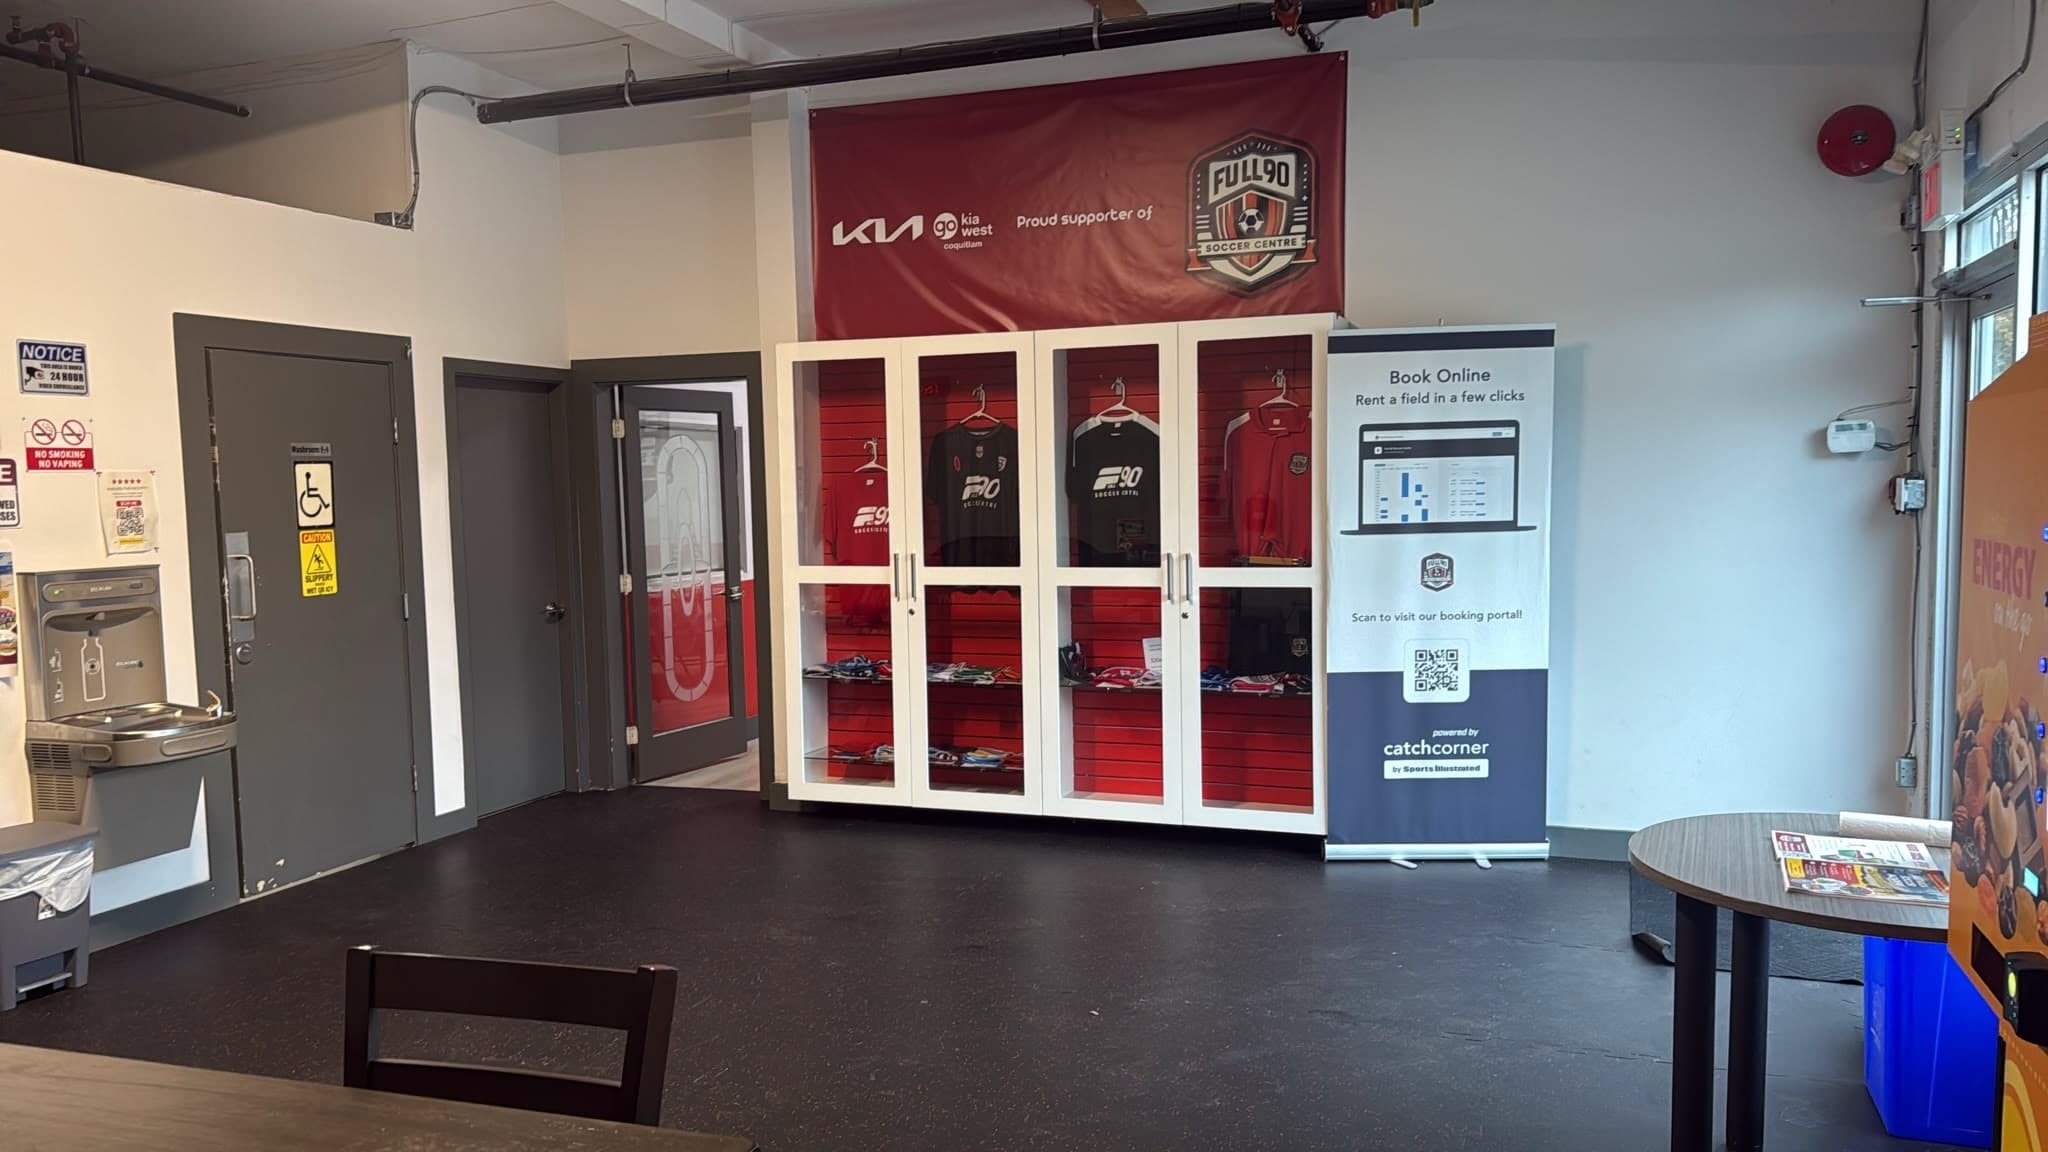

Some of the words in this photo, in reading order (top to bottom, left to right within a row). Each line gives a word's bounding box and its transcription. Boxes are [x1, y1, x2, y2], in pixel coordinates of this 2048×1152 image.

[1214, 158, 1290, 196] FULL90
[961, 212, 980, 225] kia
[1016, 213, 1058, 228] Proud
[1061, 208, 1134, 226] supporter
[1136, 205, 1153, 220] of
[832, 215, 924, 246] KIA
[961, 224, 992, 237] west
[944, 240, 983, 250] coquitlam
[1206, 241, 1250, 253] SOCCER
[1254, 237, 1297, 249] CENTRE
[22, 344, 83, 362] NOTICE
[50, 372, 60, 380] 24
[62, 373, 84, 382] HOUR
[1390, 369, 1432, 384] Book
[1437, 368, 1491, 383] Online
[1355, 394, 1385, 406] Rent
[1389, 396, 1397, 405] a
[1400, 392, 1430, 404] field
[1434, 392, 1446, 404] in
[1449, 395, 1458, 404] a
[1461, 390, 1486, 402] few
[1489, 390, 1525, 402] clicks
[34, 450, 47, 458] NO
[48, 450, 86, 459] SMOKING
[38, 460, 51, 468] NO
[52, 460, 83, 468] VAPING
[304, 533, 332, 543] CAUTION
[1972, 538, 2037, 600] ENERGY
[305, 574, 334, 583] SLIPPERY
[1352, 612, 1376, 622] Scan
[1380, 613, 1392, 622] to
[1395, 612, 1416, 622] visit
[1418, 614, 1437, 622] our
[1440, 610, 1484, 622] booking
[1487, 610, 1523, 622] portal!
[1432, 728, 1468, 738] powered
[1468, 728, 1479, 737] by
[1384, 739, 1490, 756] catchcorner
[1434, 764, 1481, 772] Illustrated
